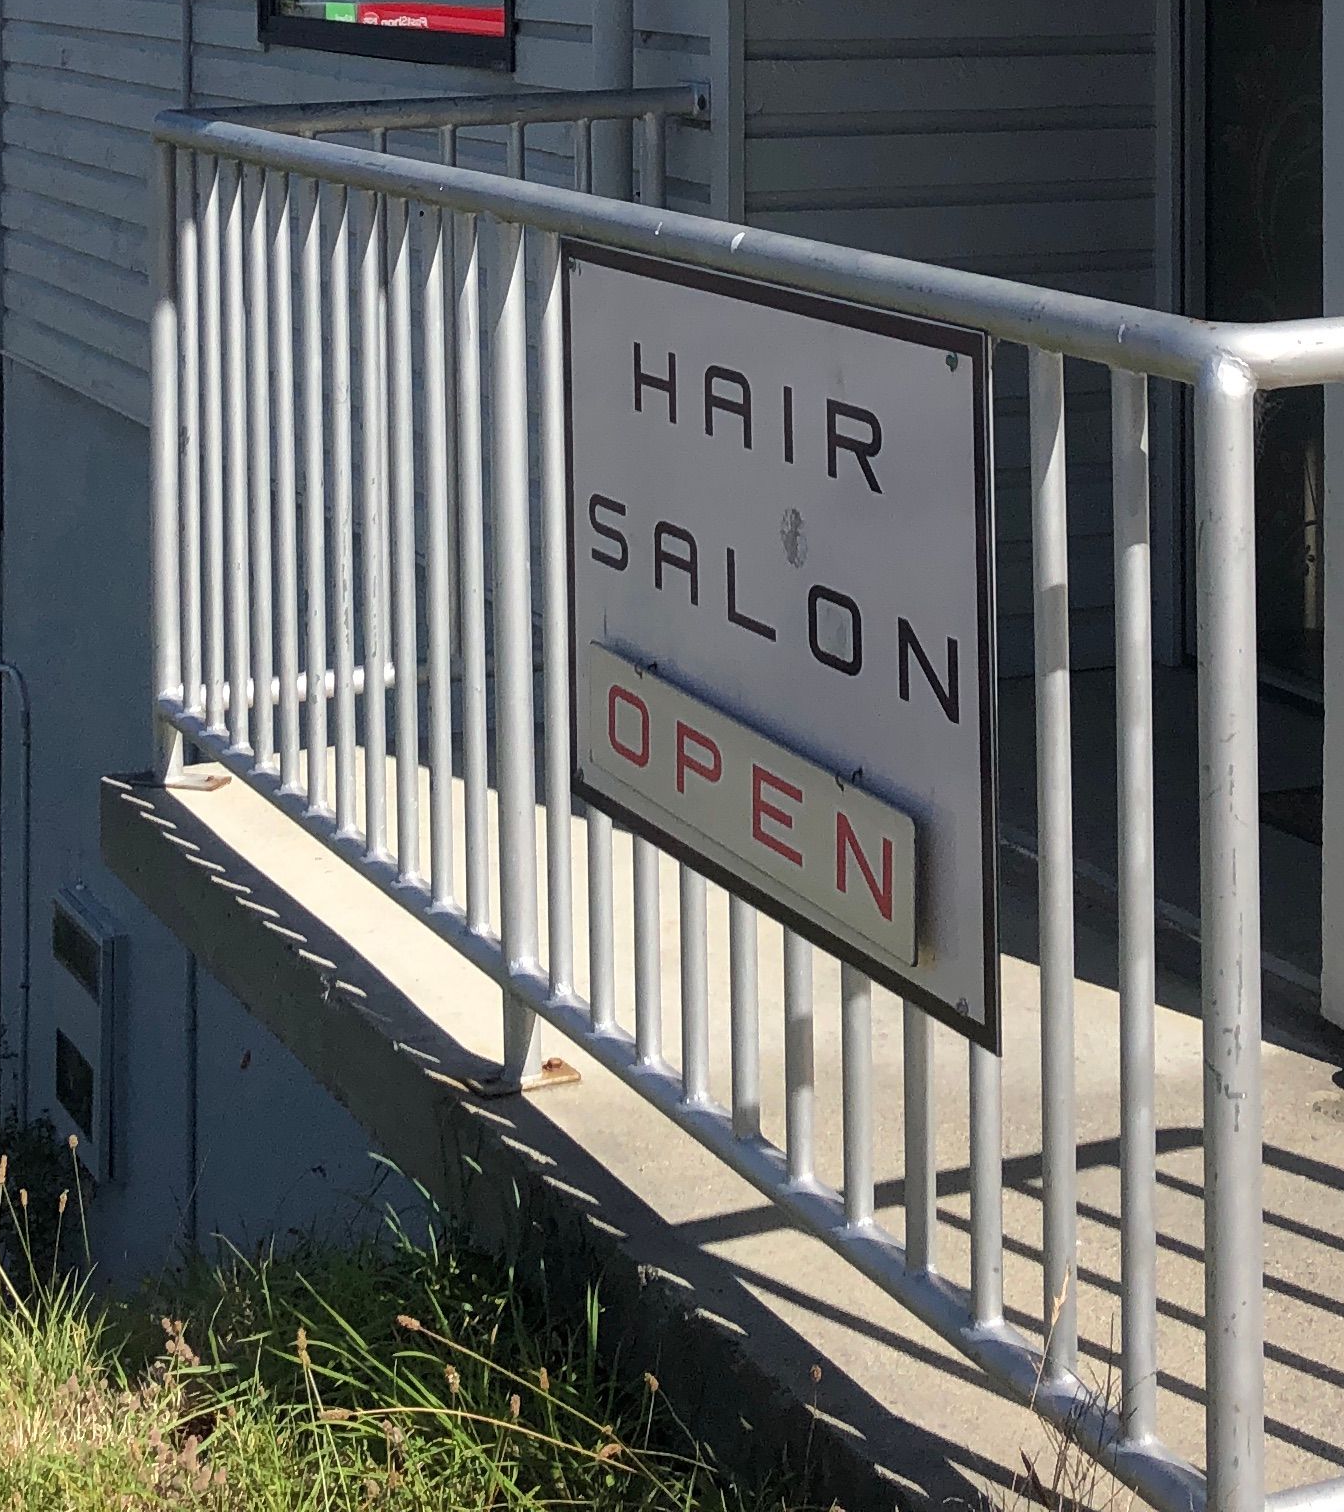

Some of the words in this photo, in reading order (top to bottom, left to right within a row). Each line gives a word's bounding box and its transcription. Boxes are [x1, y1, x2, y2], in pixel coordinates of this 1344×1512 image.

[633, 342, 883, 495] HAIR
[588, 493, 960, 725] SALON
[608, 684, 893, 923] OPEN
